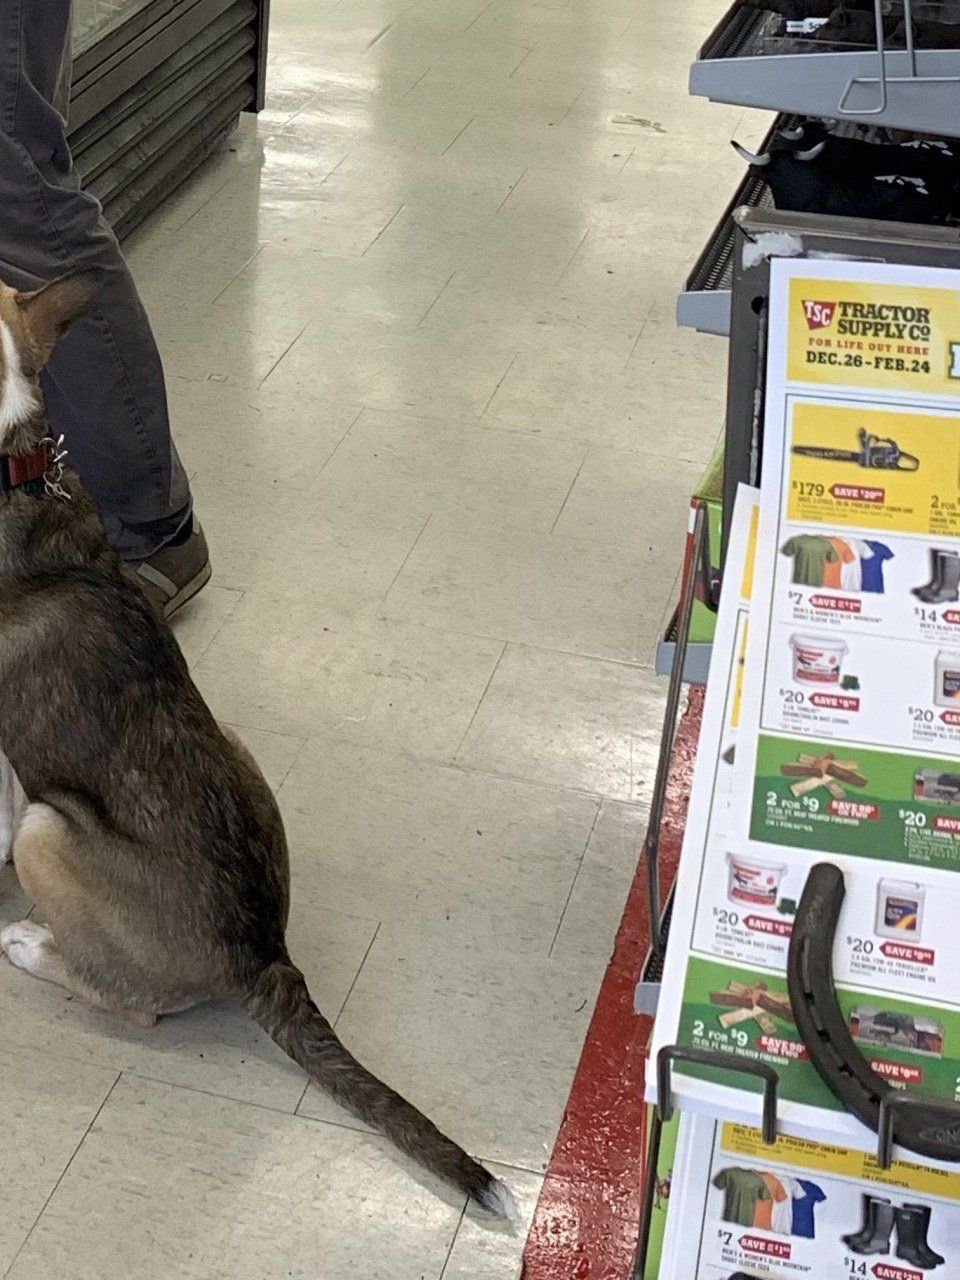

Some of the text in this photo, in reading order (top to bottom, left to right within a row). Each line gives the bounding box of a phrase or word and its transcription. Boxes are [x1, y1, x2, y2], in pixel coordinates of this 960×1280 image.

[804, 300, 831, 327] TSC
[837, 301, 930, 324] TRACTOR
[837, 319, 908, 340] SUPPLY
[808, 337, 930, 356] FOR LIFE OUT HERE
[792, 480, 859, 498] $179 SAVE
[930, 494, 957, 510] 2 FOR
[788, 590, 803, 605] $7
[811, 598, 836, 608] SAVE
[914, 606, 937, 622] $14
[779, 688, 838, 708] $20 SAVE
[908, 706, 934, 722] $20
[766, 791, 778, 807] 2
[781, 799, 801, 811] FOR
[802, 795, 820, 812] $9
[898, 808, 926, 828] $20
[712, 906, 774, 932] $20 SAVE
[846, 936, 913, 959] $20 SAVE
[692, 1020, 705, 1037] 2
[708, 1030, 729, 1043] FOR
[731, 1028, 749, 1048] $9
[871, 1061, 899, 1076] SAVE
[718, 1229, 766, 1251] $7 SAVE
[844, 1256, 902, 1280] $14 SAVE
